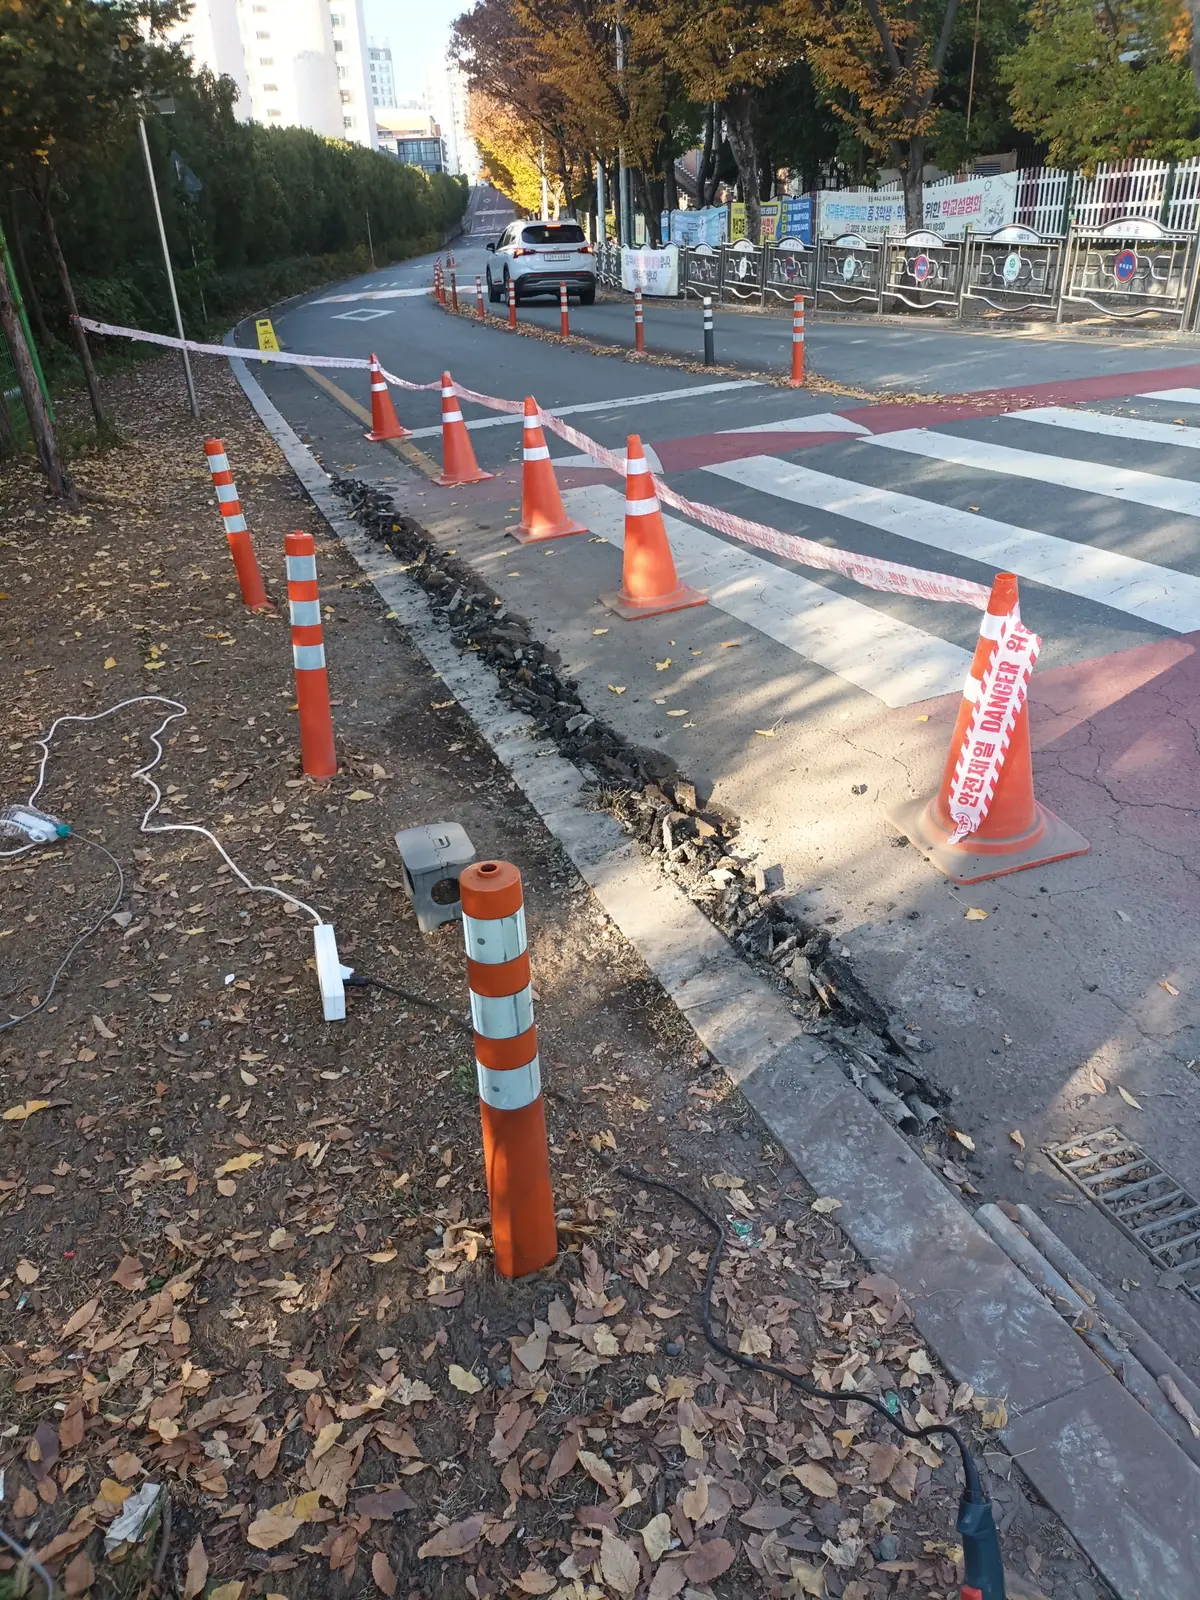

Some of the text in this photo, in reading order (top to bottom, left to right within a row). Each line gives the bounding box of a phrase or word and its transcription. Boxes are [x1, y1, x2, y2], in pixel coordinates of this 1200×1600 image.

[925, 201, 941, 219] 위한
[942, 194, 982, 216] 학교설명회
[957, 740, 996, 808] 안전제일
[980, 660, 1020, 734] DANGER
